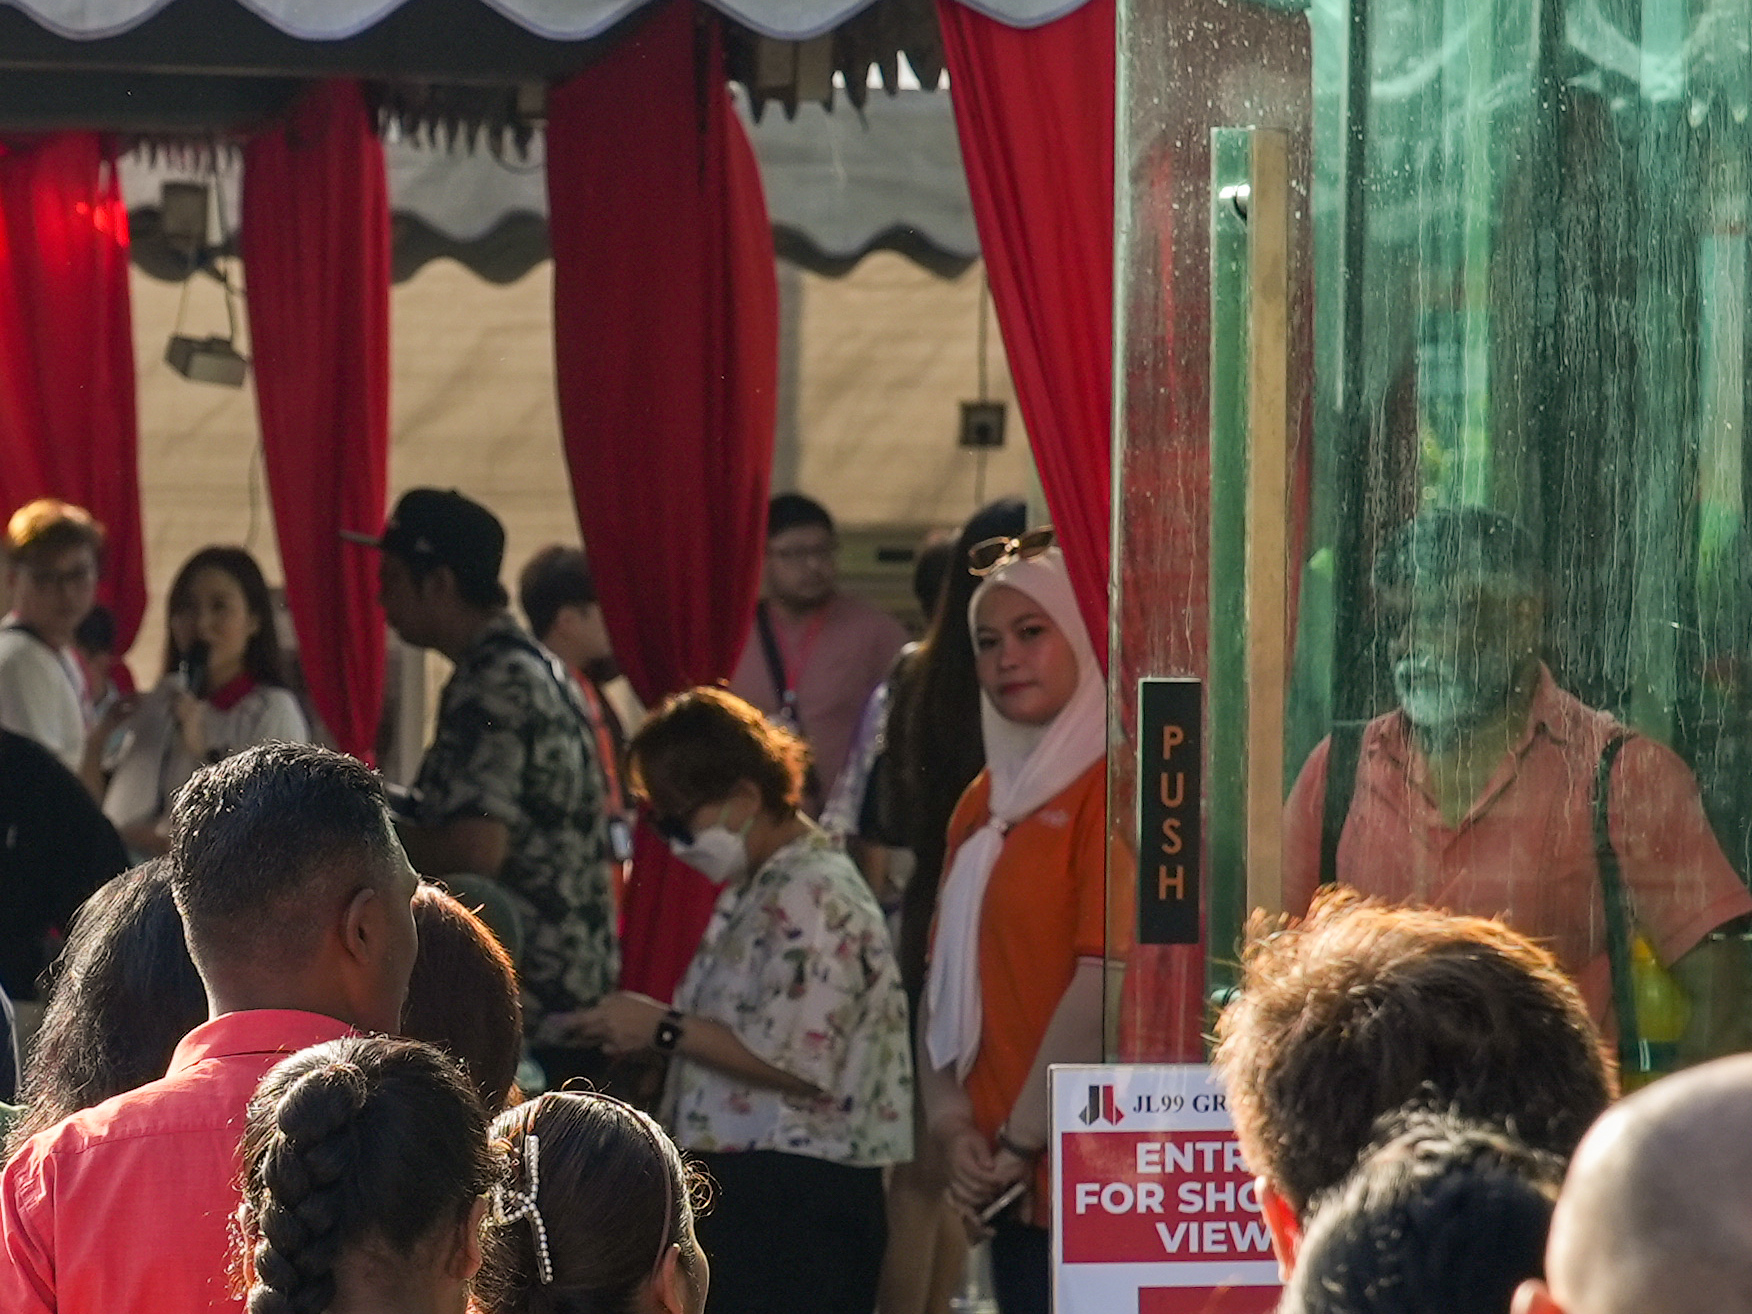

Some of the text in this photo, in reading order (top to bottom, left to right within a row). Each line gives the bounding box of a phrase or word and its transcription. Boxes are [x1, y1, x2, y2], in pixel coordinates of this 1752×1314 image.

[1158, 725, 1184, 900] PUSH
[1133, 1094, 1184, 1114] JL99
[1136, 1141, 1248, 1174] ENTR
[1075, 1181, 1263, 1215] FOR SHO
[1155, 1221, 1273, 1253] VIEW
